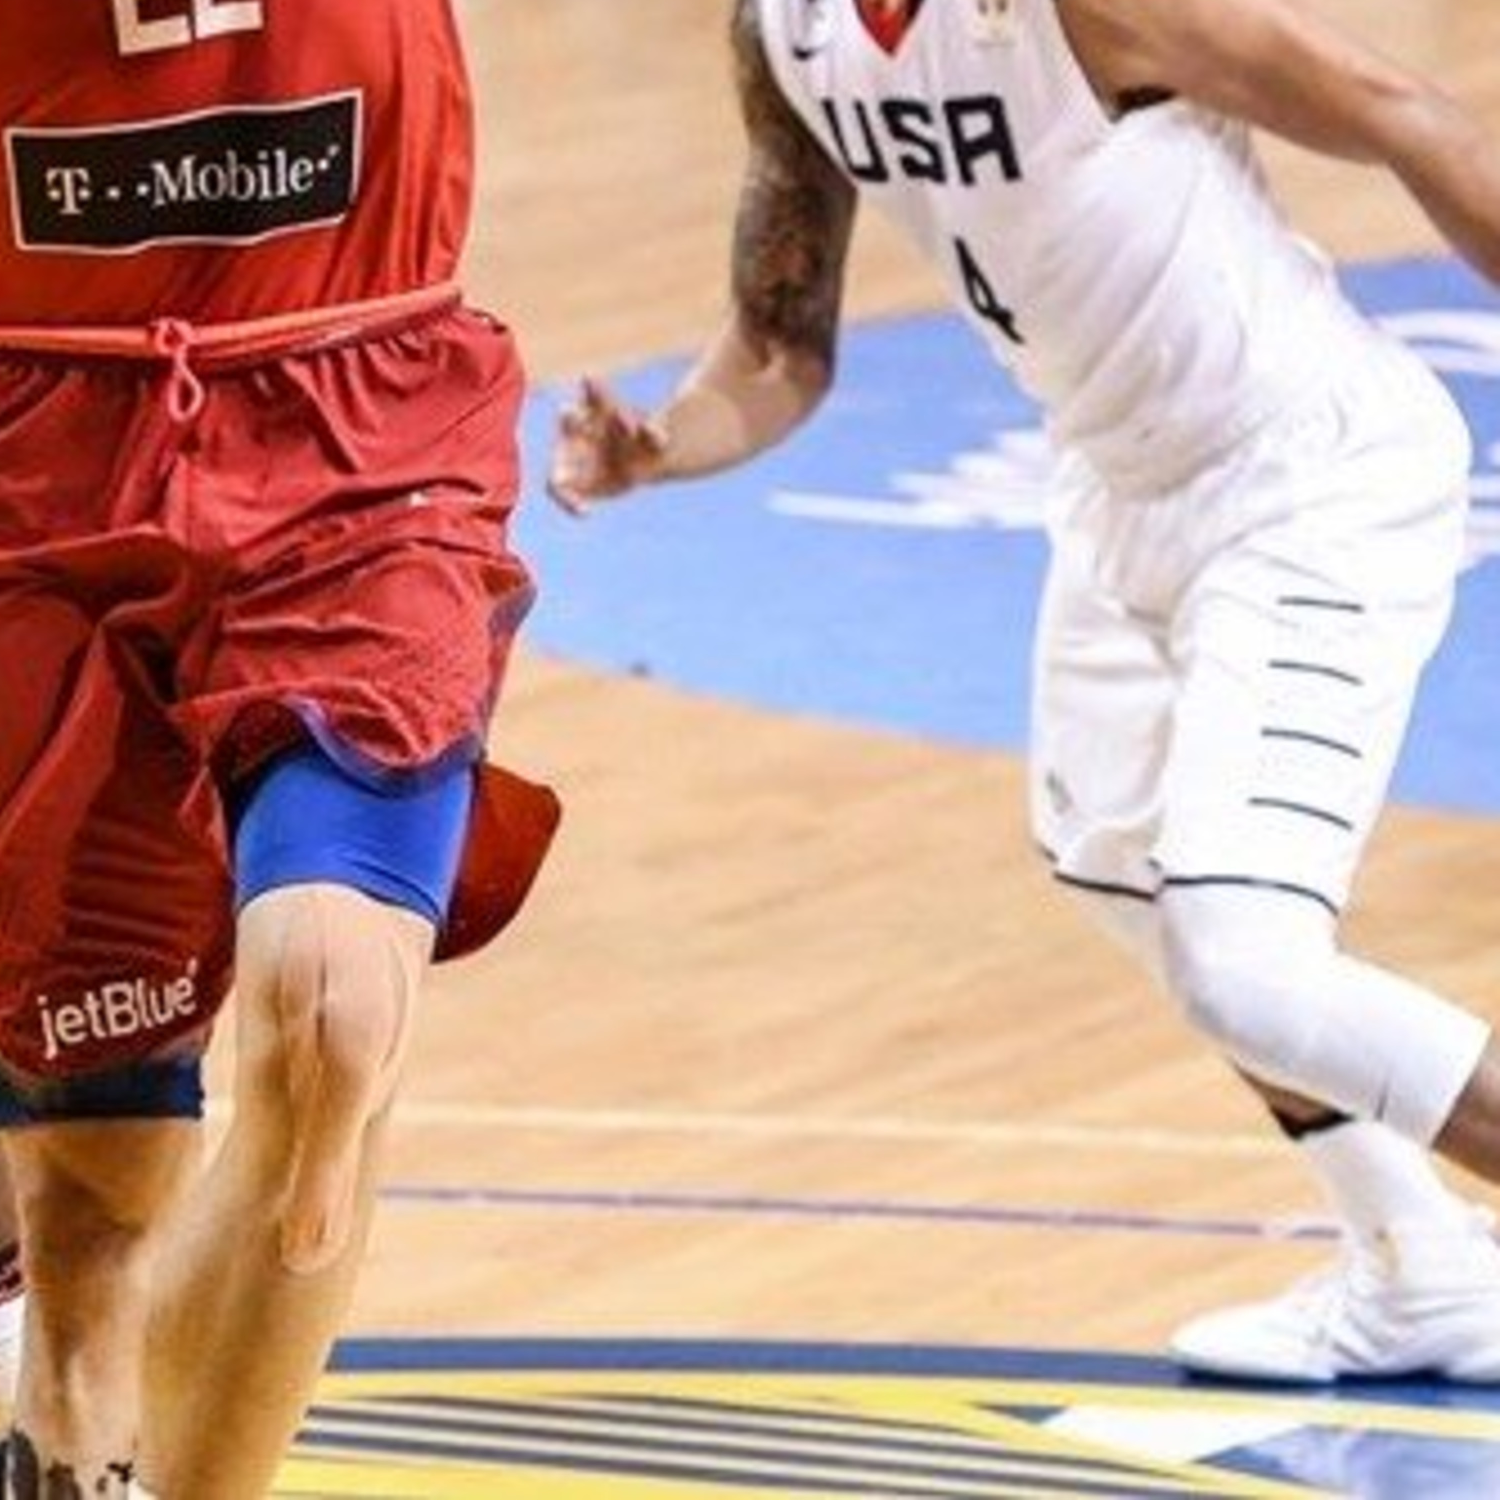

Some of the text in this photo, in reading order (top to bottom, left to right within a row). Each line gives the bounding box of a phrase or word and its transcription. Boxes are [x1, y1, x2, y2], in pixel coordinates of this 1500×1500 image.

[820, 94, 1023, 186] USA
[954, 235, 1026, 345] 4
[37, 974, 198, 1061] jetBlue
